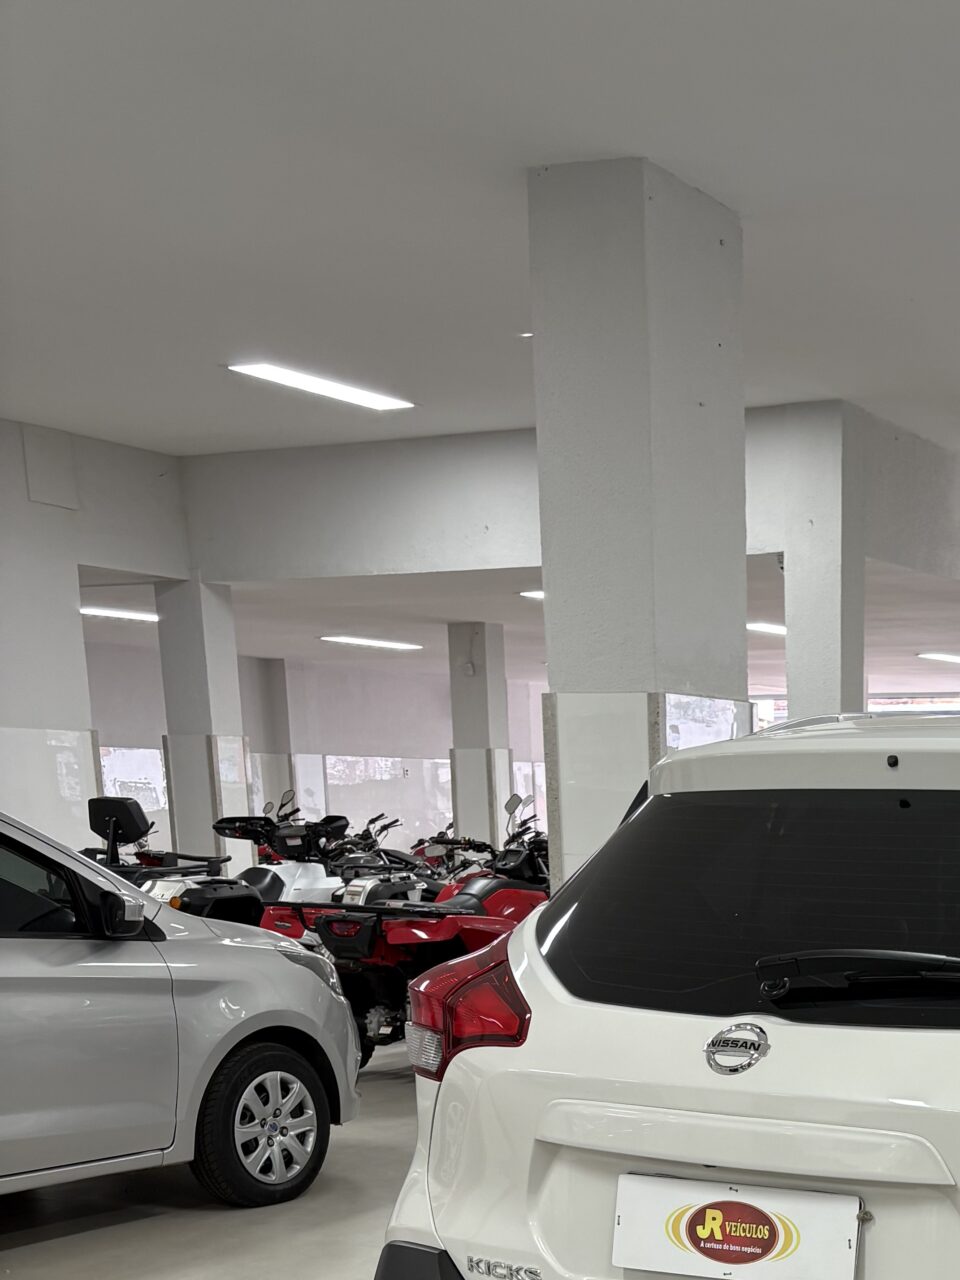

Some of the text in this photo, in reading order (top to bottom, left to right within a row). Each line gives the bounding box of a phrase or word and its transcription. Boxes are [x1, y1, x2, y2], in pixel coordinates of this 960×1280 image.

[707, 1039, 762, 1051] NISSAN
[696, 1208, 769, 1241] JR VEÍCULOS
